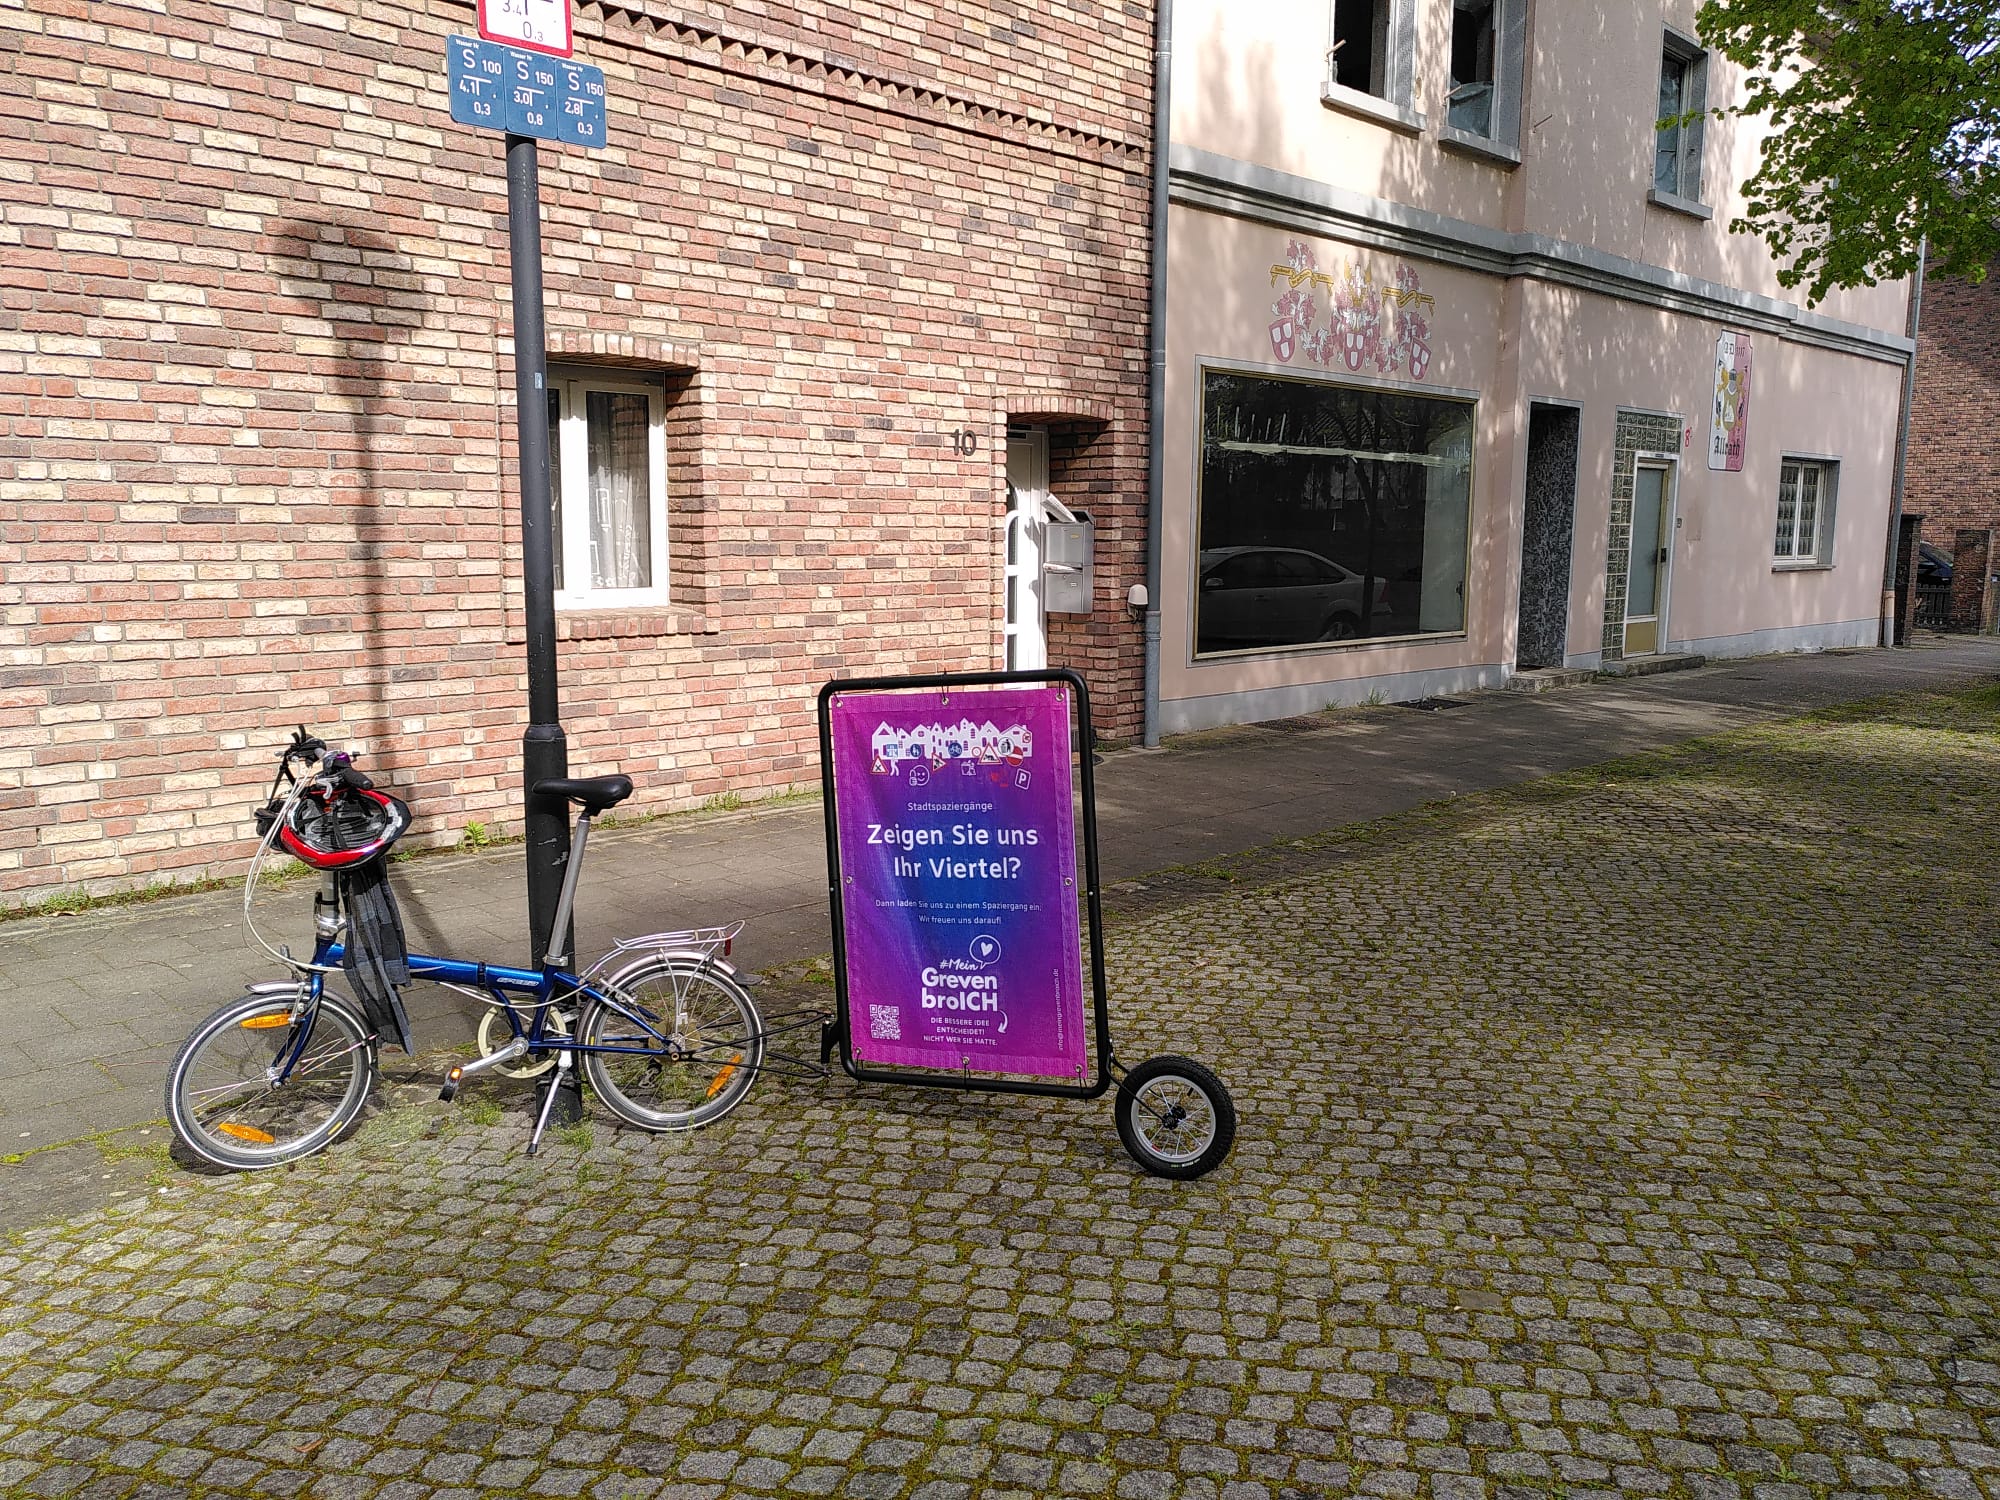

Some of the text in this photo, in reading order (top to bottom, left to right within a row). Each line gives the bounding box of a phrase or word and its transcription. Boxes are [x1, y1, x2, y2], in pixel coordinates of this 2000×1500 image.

[523, 21, 544, 42] 0.3
[462, 48, 502, 75] S 100
[516, 61, 554, 86] S 150
[567, 72, 604, 97] S 150
[473, 101, 491, 116] 0.3
[526, 111, 544, 126] 0.8
[577, 121, 594, 136] 0.3
[950, 428, 977, 456] 10
[1713, 435, 1741, 460] Allrath
[907, 801, 993, 814] Stadtspaziergänge
[867, 823, 1039, 851] Zeigen Sie uns
[894, 856, 1021, 879] Ihr Viertel?
[875, 899, 895, 907] Dann
[897, 898, 917, 907] laden
[918, 900, 929, 908] Sie
[956, 901, 980, 909] einem
[982, 901, 1028, 912] Spaziergang
[918, 914, 930, 923] Wir
[931, 915, 956, 924] freuen
[939, 958, 979, 971] #Mein
[921, 966, 998, 990] Greven
[921, 987, 998, 1012] broICH
[944, 1017, 973, 1026] BESSERE
[974, 1019, 990, 1027] IDEE
[946, 1035, 961, 1043] WER
